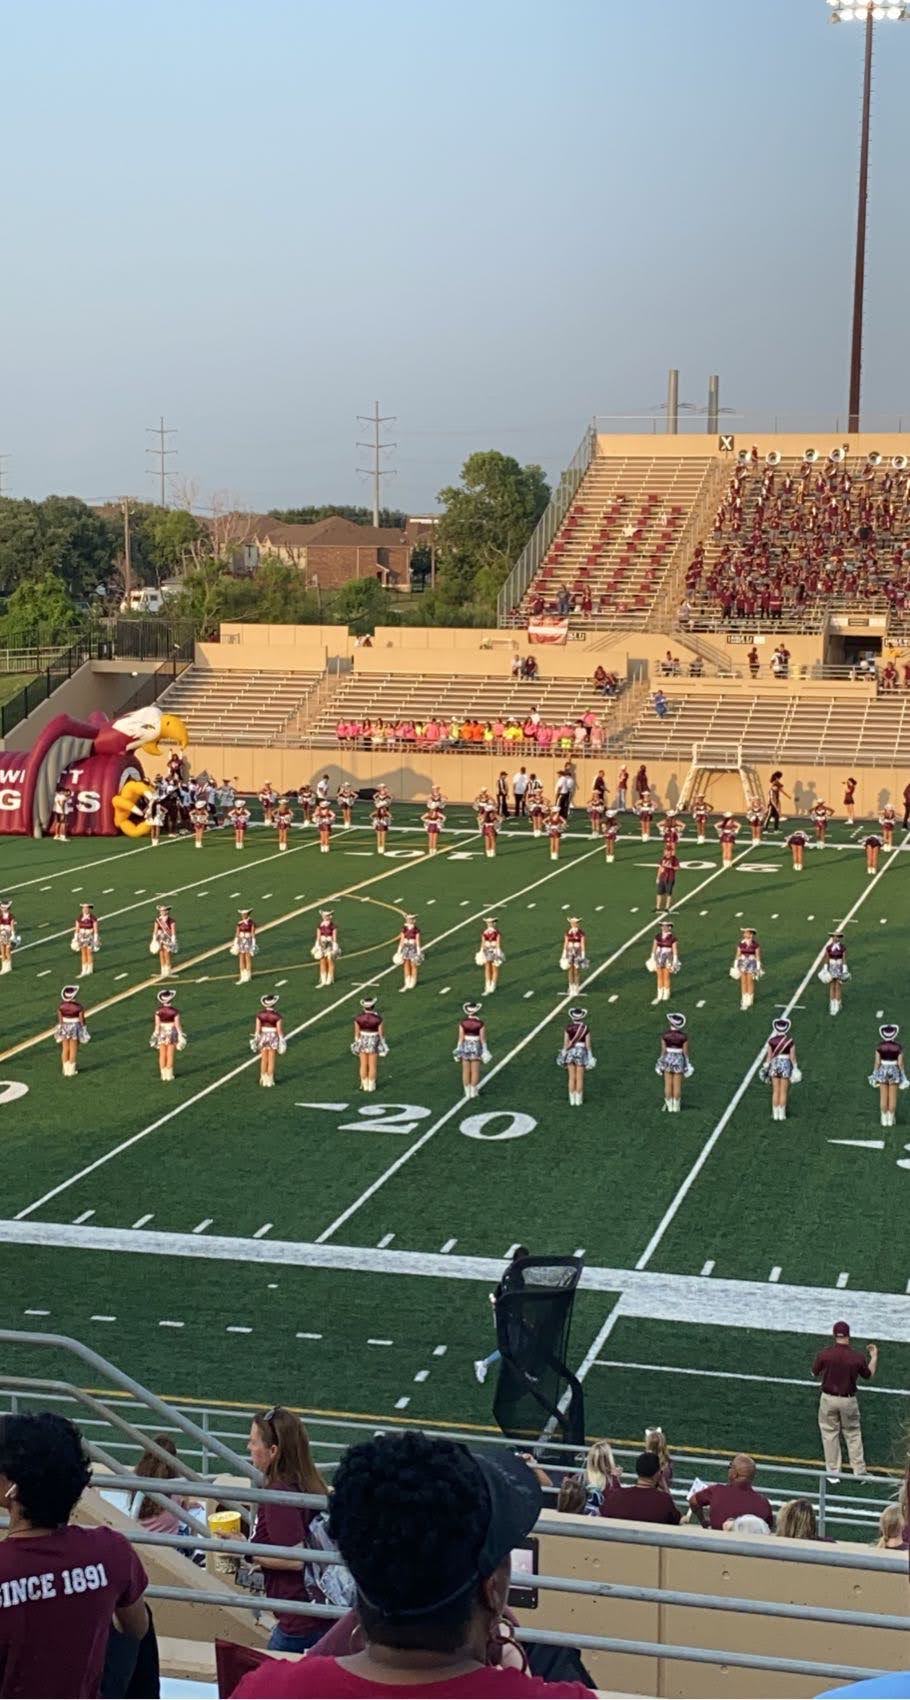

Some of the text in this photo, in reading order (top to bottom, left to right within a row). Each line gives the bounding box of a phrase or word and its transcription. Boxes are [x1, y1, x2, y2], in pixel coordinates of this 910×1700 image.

[720, 436, 733, 450] X
[337, 1103, 538, 1140] 20
[0, 1562, 109, 1609] INCE 1891
